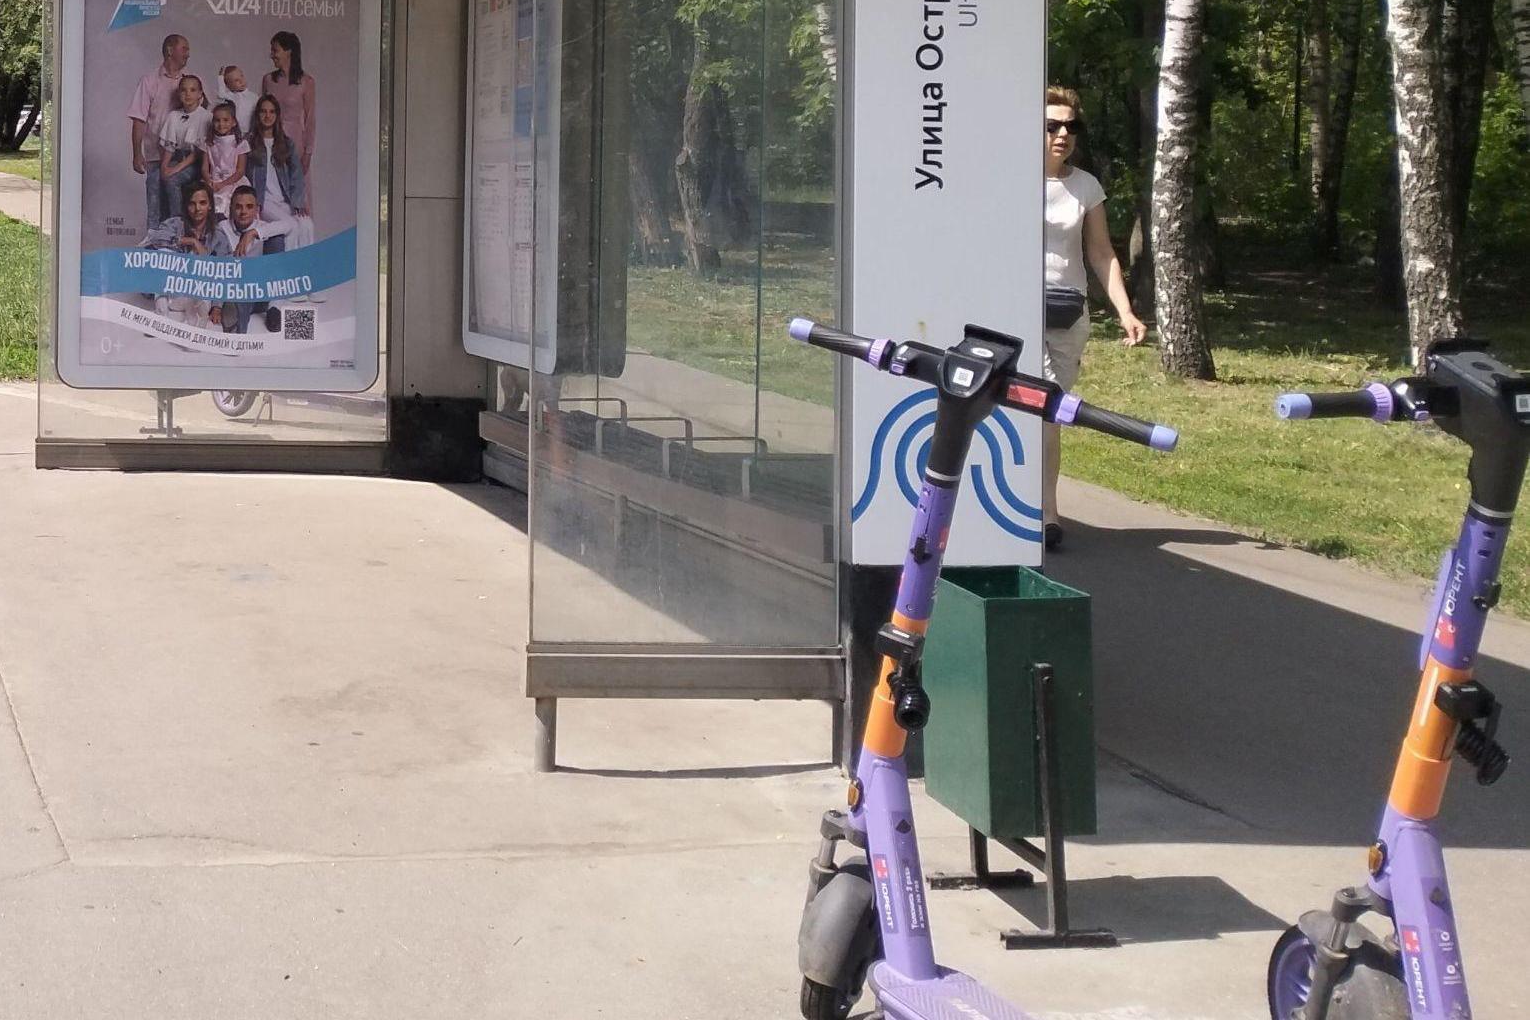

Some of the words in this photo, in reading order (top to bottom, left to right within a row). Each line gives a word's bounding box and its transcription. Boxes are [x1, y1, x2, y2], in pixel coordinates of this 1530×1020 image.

[914, 82, 947, 191] Улица
[124, 251, 190, 273] ХОРОШИХ
[191, 259, 242, 280] ЛЮДЕЙ
[164, 275, 224, 299] ДОЛЖНО
[227, 283, 264, 299] БЫТЬ
[267, 275, 312, 298] МНОГО
[100, 336, 125, 355] 0+
[120, 307, 131, 320] ВСЕ
[133, 313, 151, 327] МЕРЫ
[151, 319, 192, 339] ПОДДЕРЖКИ
[192, 333, 207, 344] ДЛЯ
[207, 336, 230, 348] СЕМЕЙ
[236, 340, 264, 351] ДЕТЬМИ
[1443, 558, 1467, 617] ЮРЕНТ
[1411, 956, 1427, 1008] ЮРЕНТ
